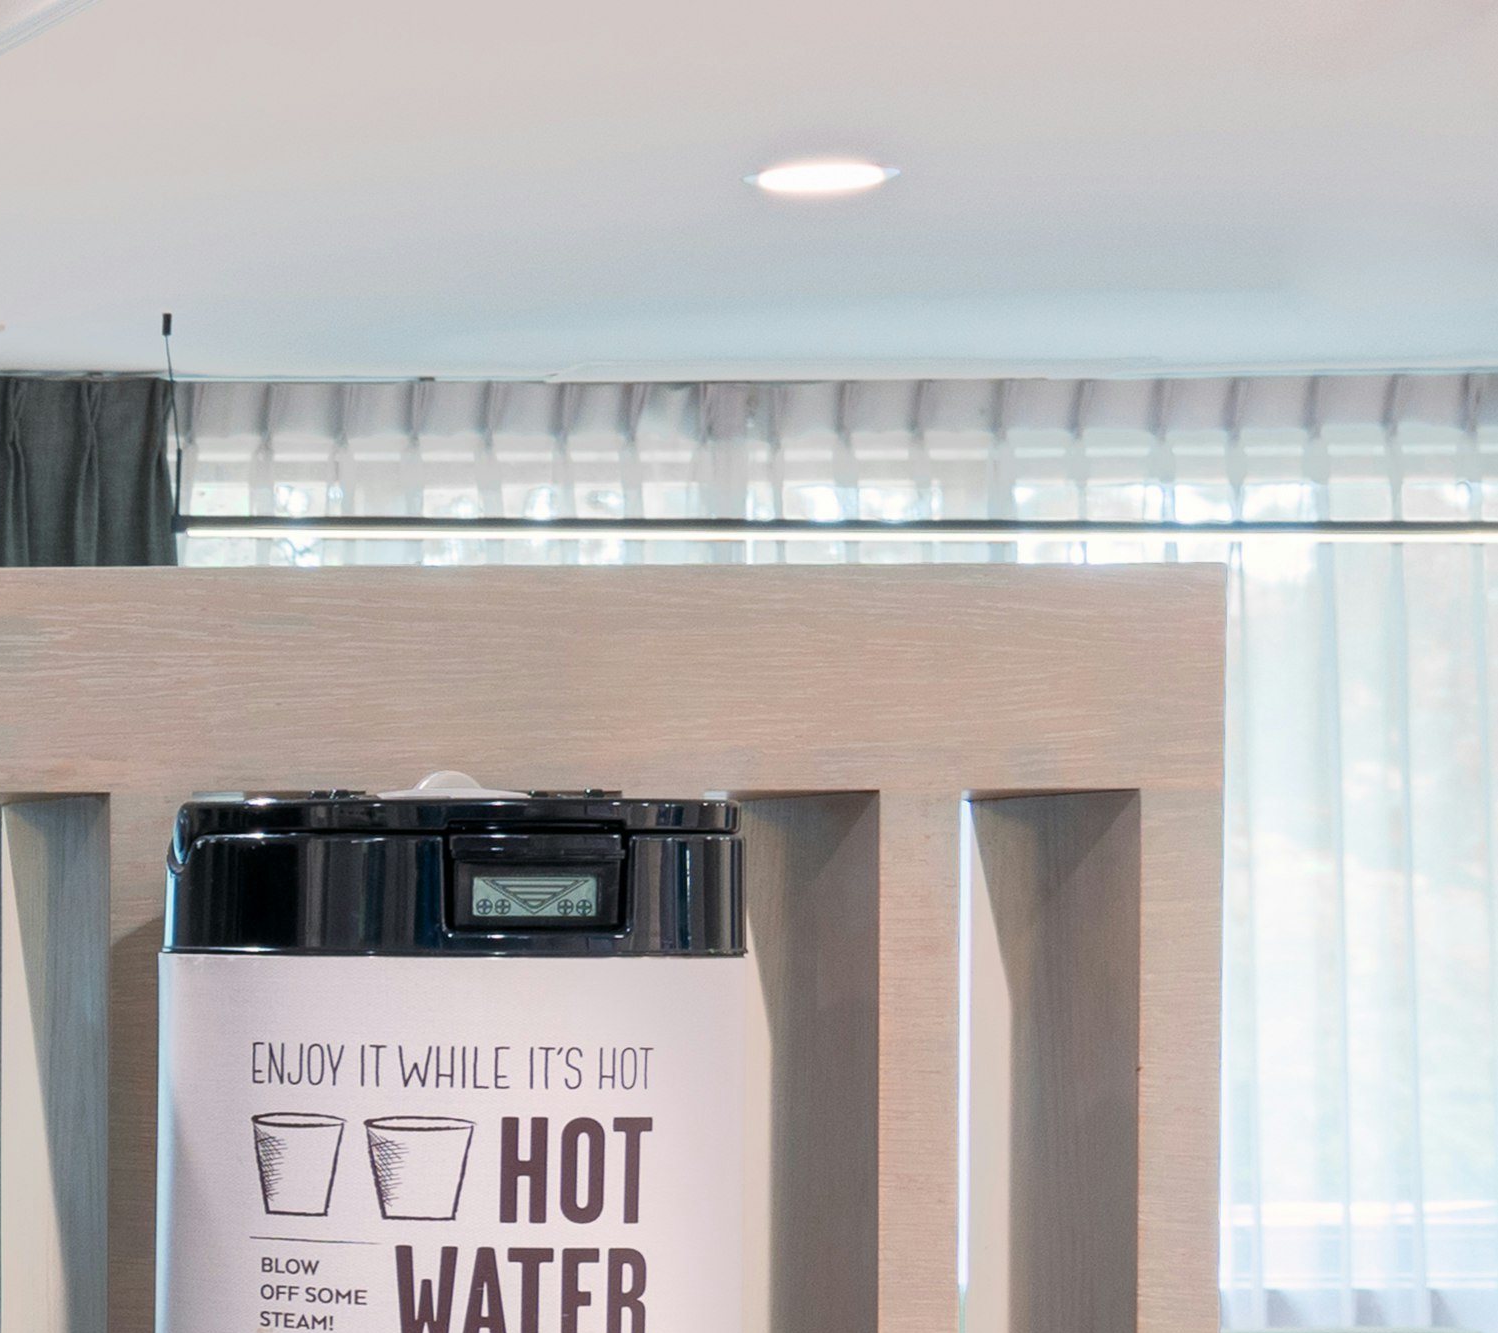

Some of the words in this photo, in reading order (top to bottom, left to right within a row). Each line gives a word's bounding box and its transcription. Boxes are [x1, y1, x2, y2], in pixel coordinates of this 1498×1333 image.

[252, 1042, 345, 1086] ENJOY
[361, 1044, 387, 1087] IT
[398, 1045, 510, 1090] WHILE
[530, 1046, 583, 1090] IT'S
[599, 1047, 654, 1090] HOT
[499, 1116, 653, 1224] HOT
[261, 1256, 320, 1276] BLOW
[260, 1284, 300, 1301] OFF
[305, 1286, 368, 1305] SOME
[260, 1310, 334, 1331] STEAM!
